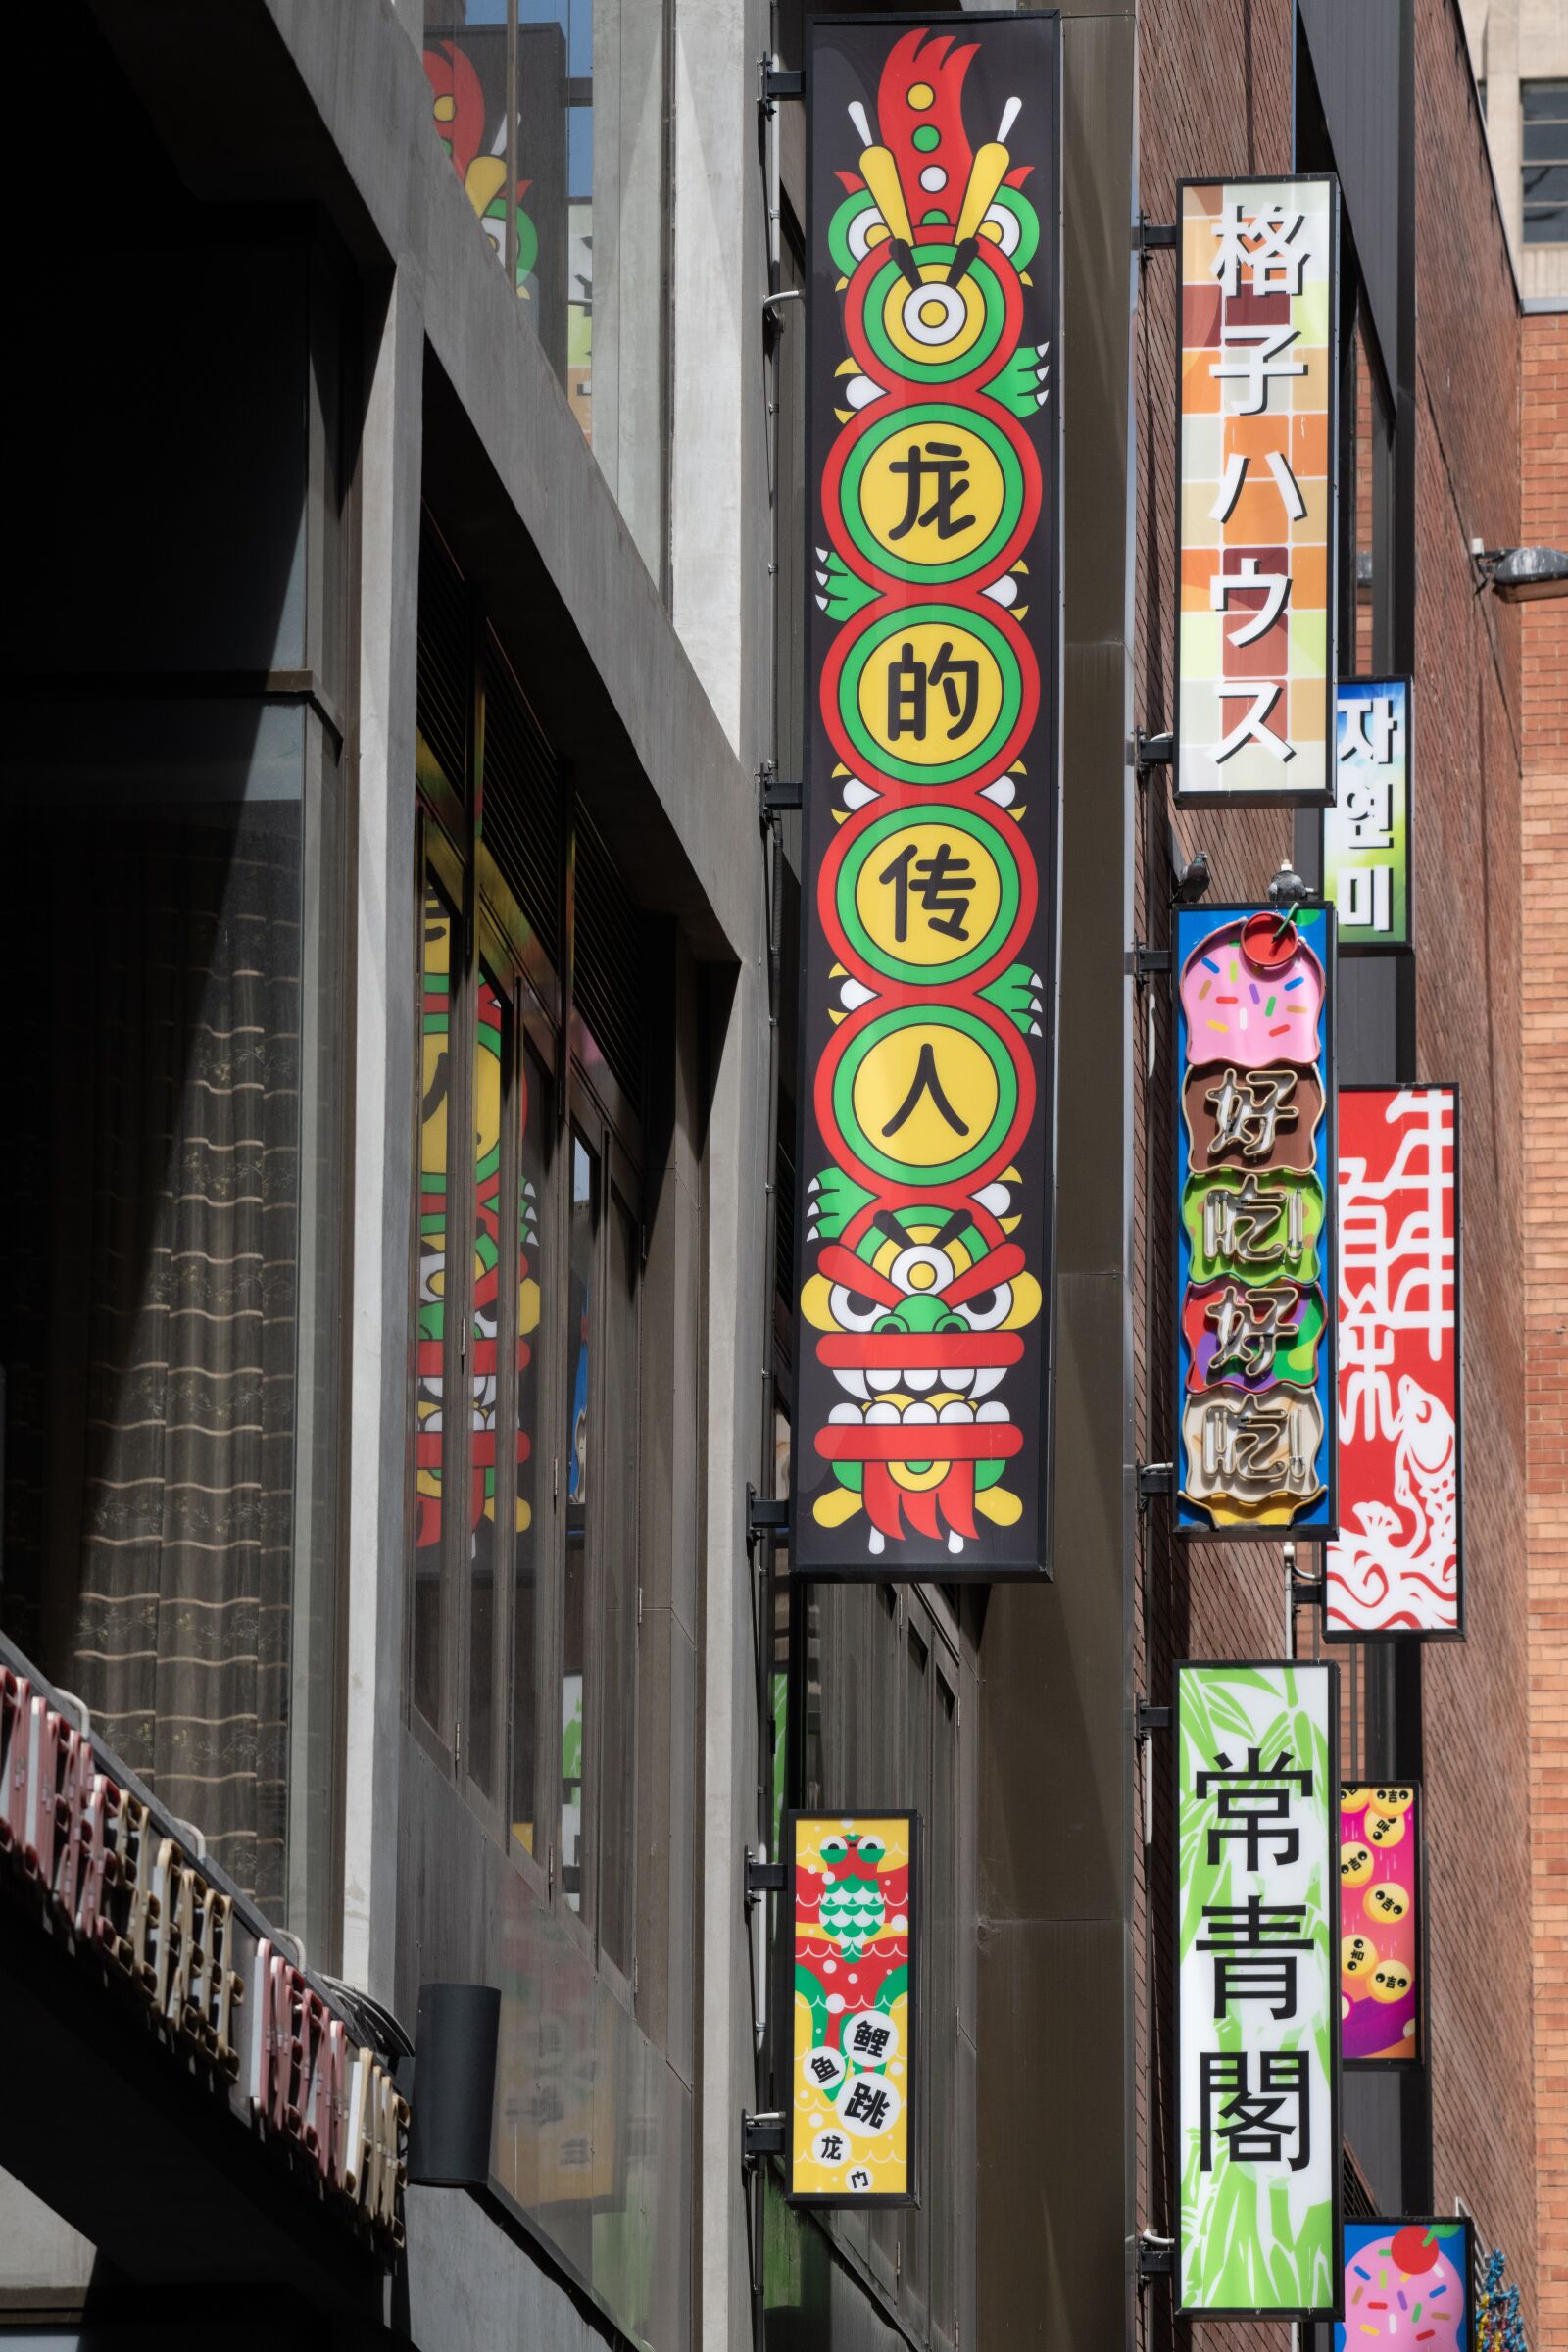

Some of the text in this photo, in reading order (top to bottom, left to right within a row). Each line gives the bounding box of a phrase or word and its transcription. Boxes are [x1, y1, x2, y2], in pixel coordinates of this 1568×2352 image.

[1207, 202, 1311, 763] 格子ハウス
[879, 442, 979, 1136] 龙的传人
[1336, 697, 1398, 931] 자연미
[1195, 1747, 1315, 2173] 常青閣
